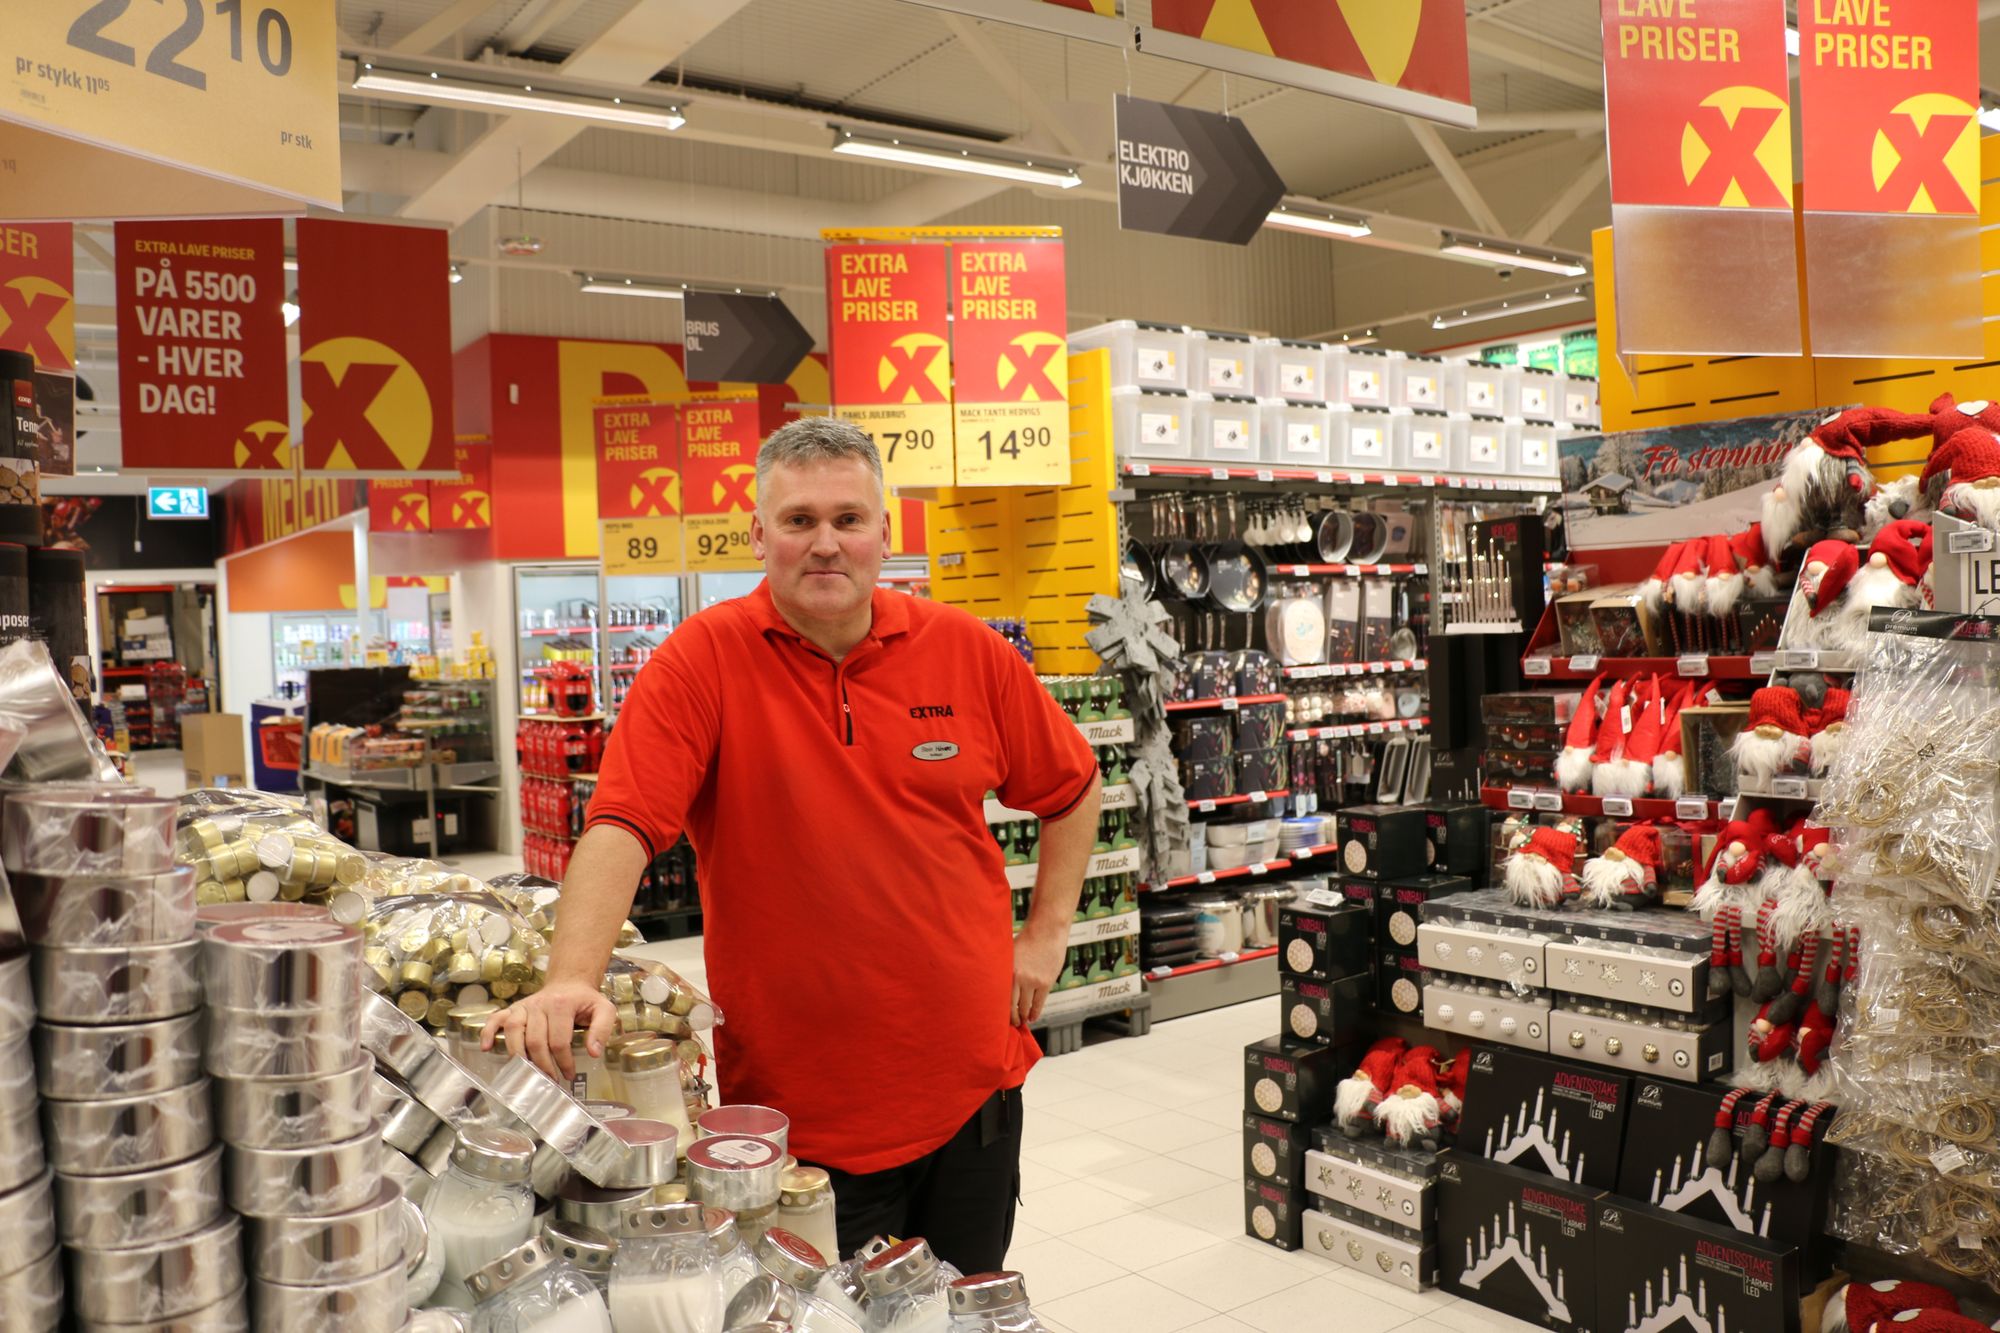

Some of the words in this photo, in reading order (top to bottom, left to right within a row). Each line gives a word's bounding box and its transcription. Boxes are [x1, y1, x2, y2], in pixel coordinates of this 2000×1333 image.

[1814, 0, 1891, 27] LAVE
[1619, 26, 1741, 63] PRISER
[1814, 33, 1933, 70] PRISER
[16, 55, 33, 75] pr
[37, 62, 82, 91] stykk
[281, 130, 293, 146] pr
[295, 133, 312, 150] stk
[1120, 139, 1189, 171] ELEKTRO
[1120, 164, 1193, 195] KJØKKEN
[135, 240, 177, 254] EXTRA
[179, 243, 211, 257] LAVE
[212, 246, 255, 261] PRISER
[841, 253, 909, 274] EXTRA
[961, 252, 1028, 273] EXTRA
[135, 258, 178, 299] PÅ
[185, 270, 256, 304] 5500
[841, 277, 892, 298] LAVE
[961, 276, 1011, 296] LAVE
[842, 300, 919, 322] PRISER
[962, 299, 1037, 320] PRISER
[135, 305, 243, 341] VARER
[686, 320, 720, 336] BRUS
[157, 345, 244, 379] HVER
[139, 383, 216, 415] DAG!
[604, 413, 650, 428] EXTRA
[686, 409, 733, 425] EXTRA
[960, 408, 981, 417] MACK
[983, 408, 1006, 416] TANTE
[605, 430, 639, 445] LAVE
[687, 426, 721, 441] LAVE
[605, 445, 658, 461] PRISER
[688, 442, 741, 458] PRISER
[1642, 443, 1680, 481] Få
[628, 537, 658, 559] 89
[1885, 622, 1918, 632] premium
[909, 705, 954, 719] EXTRA
[1088, 724, 1123, 740] Mack
[1095, 853, 1129, 870] Mack
[1096, 917, 1129, 934] Mack
[1097, 980, 1131, 998] Mack
[1591, 1110, 1603, 1120] LED
[1592, 1101, 1616, 1112] 7-ARMET
[1563, 1219, 1586, 1231] 7-ARMET
[1564, 1227, 1576, 1237] LED
[1745, 1276, 1773, 1292] 7-ARMET
[1745, 1285, 1760, 1298] LED
